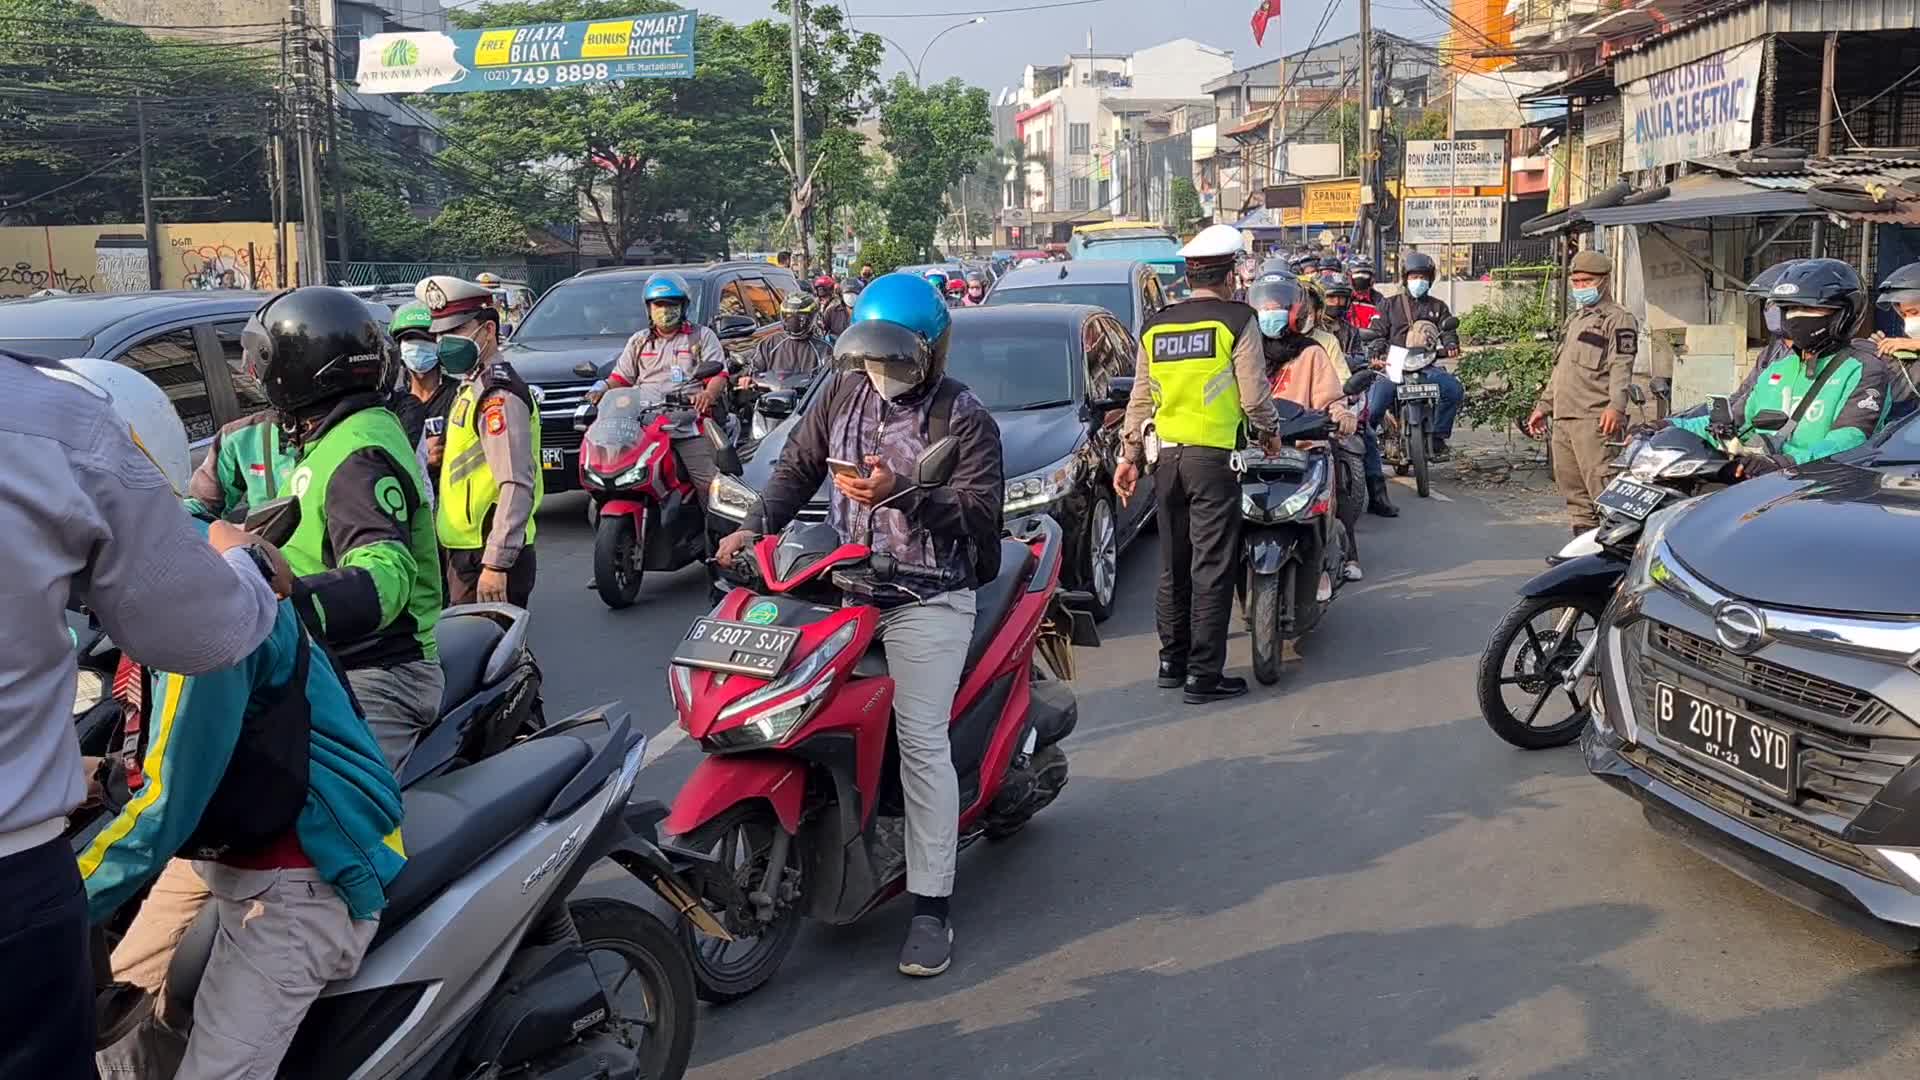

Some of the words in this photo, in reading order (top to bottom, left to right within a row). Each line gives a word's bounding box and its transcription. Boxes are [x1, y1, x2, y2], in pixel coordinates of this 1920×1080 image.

[514, 25, 567, 43] BIAYA
[632, 15, 688, 37] SMART
[480, 40, 507, 50] FREE
[587, 32, 626, 45] BONUS
[361, 67, 443, 82] ARKAMAYA
[483, 70, 510, 82] (021)
[510, 67, 550, 86] 749
[556, 64, 609, 83] 8898
[1679, 53, 1727, 92] LISTRIK
[1676, 78, 1744, 136] ELECTRIC
[1433, 142, 1476, 151] NOTARIS
[1408, 154, 1424, 165] RONY
[1313, 192, 1352, 200] SPANDUK
[1408, 200, 1432, 210] PEJABAT
[1434, 200, 1460, 208] PEMBAT
[1464, 200, 1478, 208] AKTA
[1480, 200, 1498, 208] TANAH
[1408, 218, 1424, 227] RONY
[1155, 333, 1210, 356] POLISI
[694, 624, 706, 640] B
[710, 626, 752, 646] 4907
[756, 632, 790, 652] SJX
[1660, 688, 1674, 722] B
[1690, 701, 1737, 748] 2017
[1750, 724, 1787, 770] SYD
